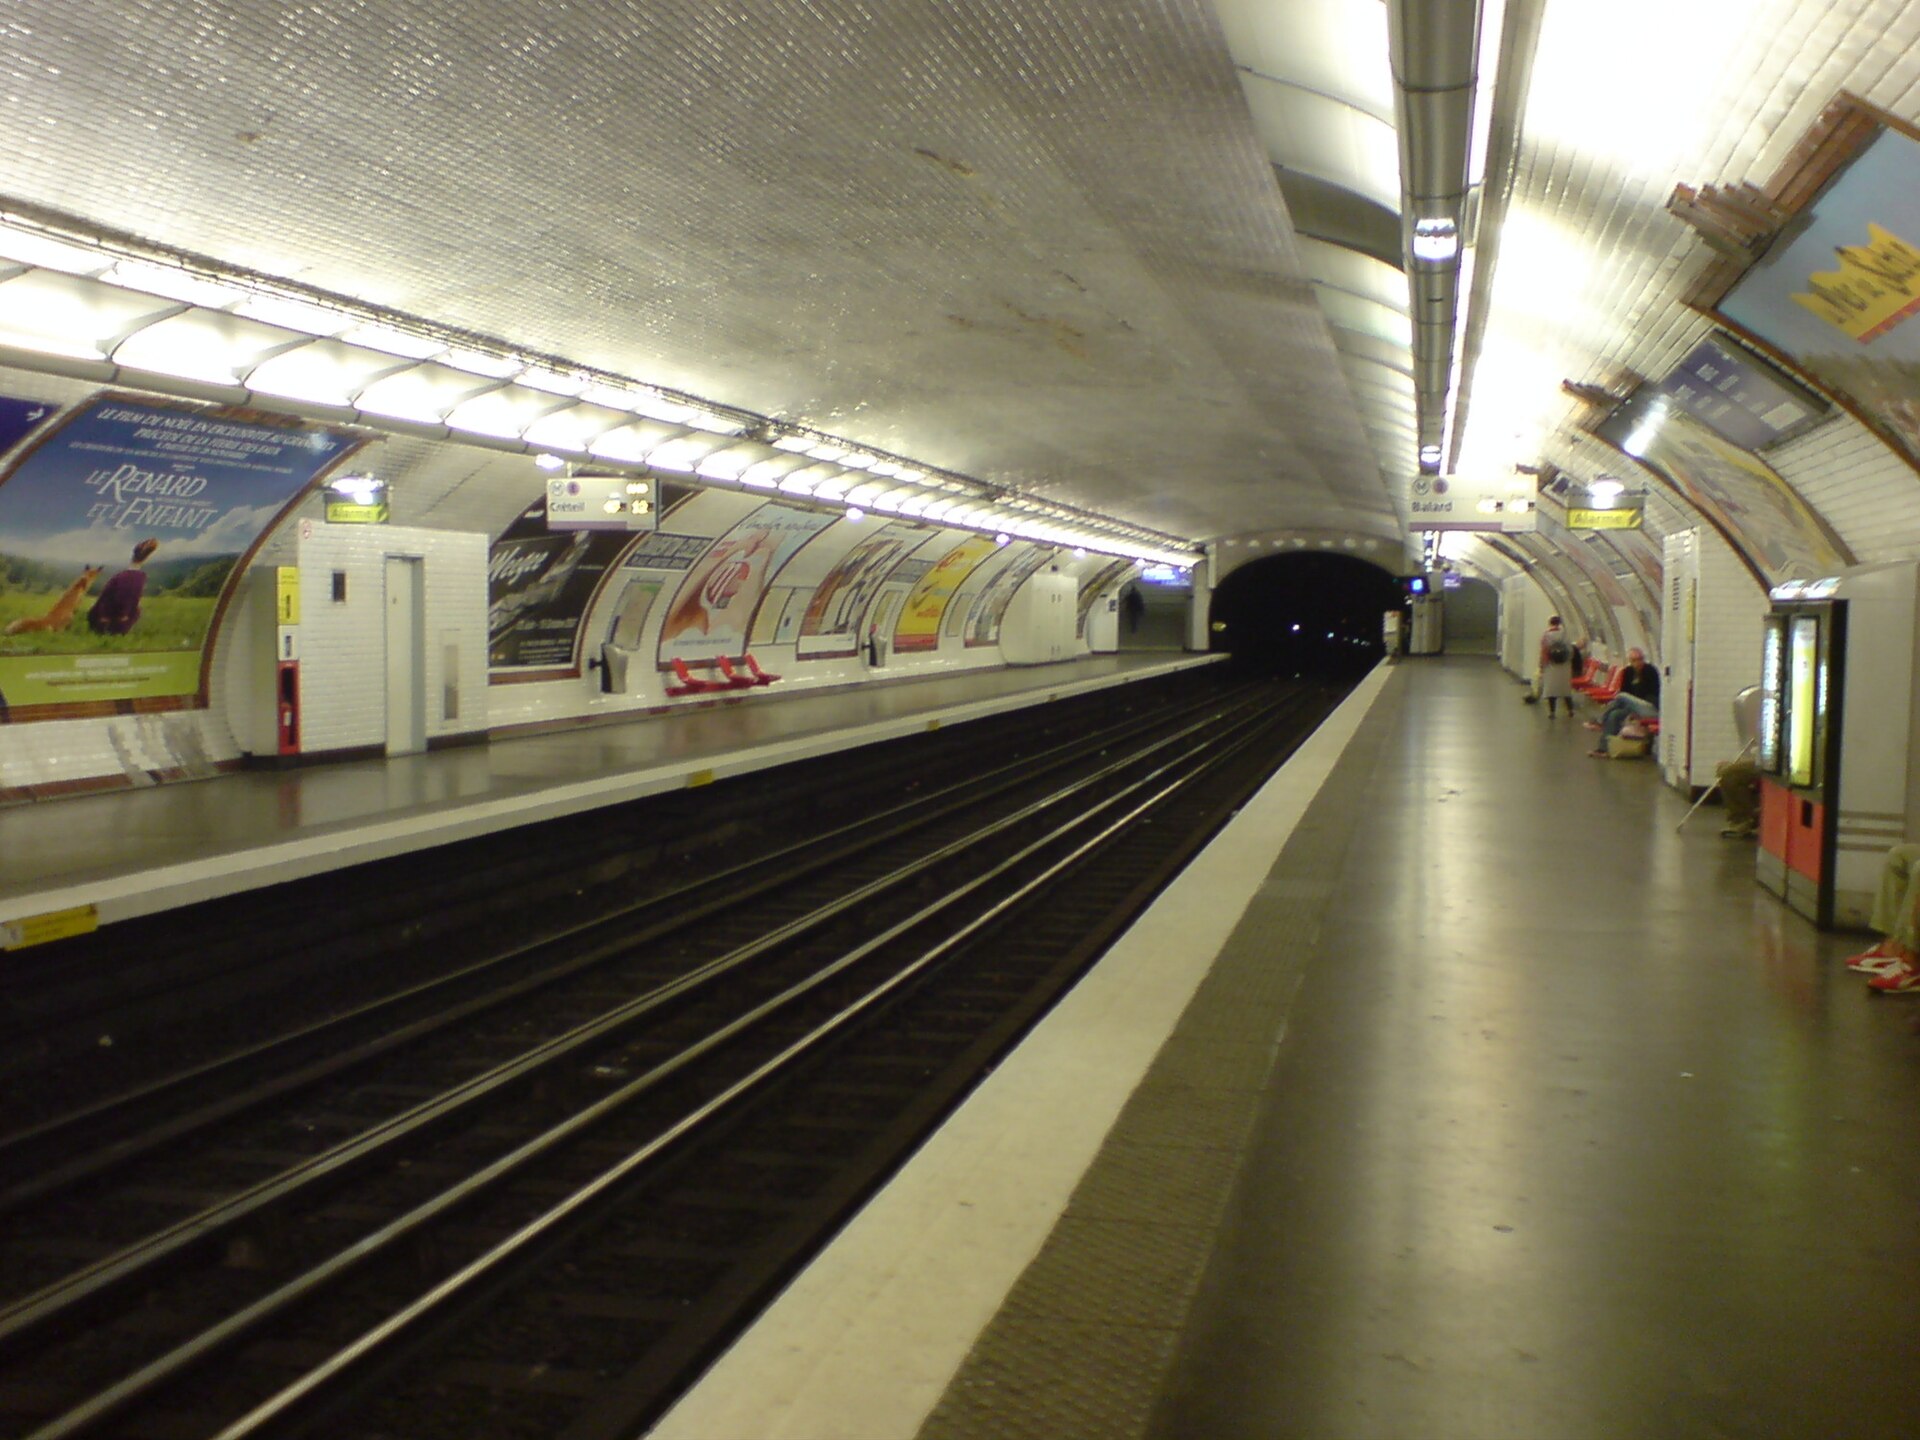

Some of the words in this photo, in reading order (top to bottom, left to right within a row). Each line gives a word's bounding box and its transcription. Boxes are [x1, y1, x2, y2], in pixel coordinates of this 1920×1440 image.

[85, 470, 111, 485] LE
[97, 464, 207, 502] RENARD
[87, 503, 113, 518] ET
[1411, 501, 1453, 512] Balard
[1574, 513, 1624, 525] Alarme
